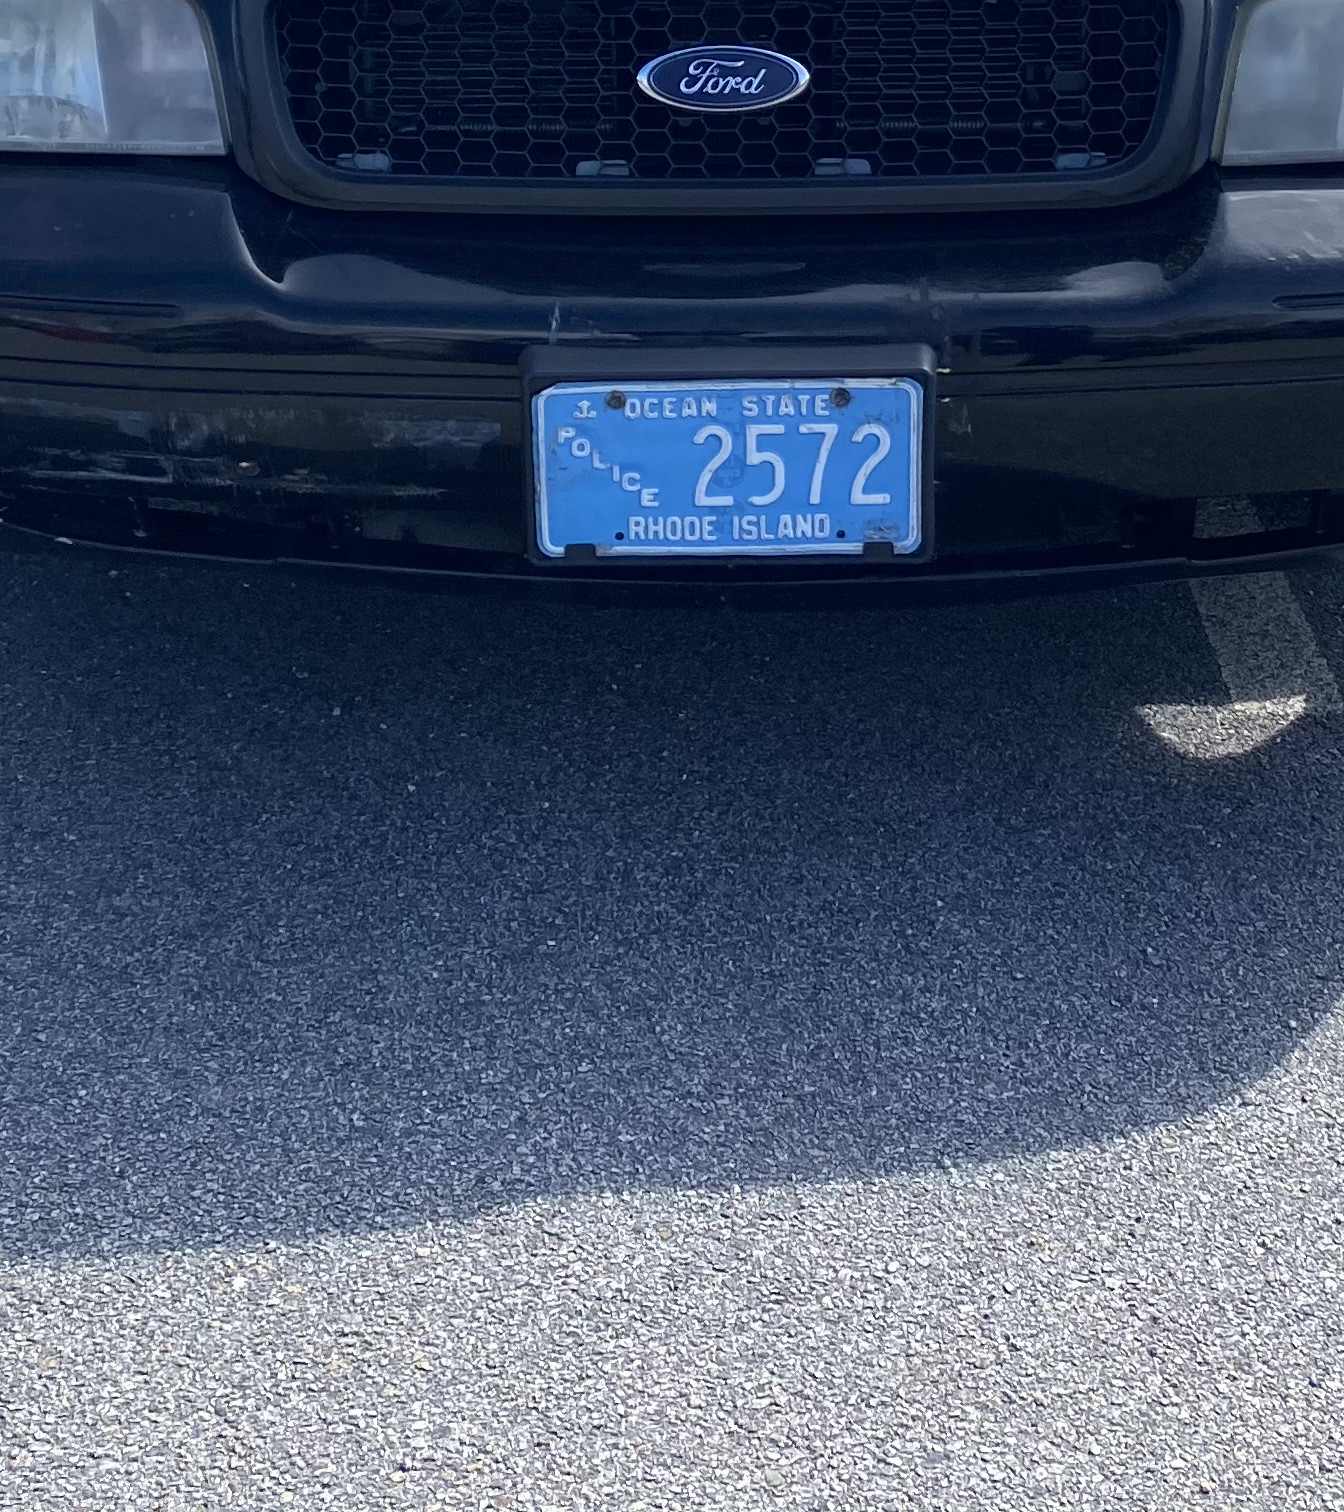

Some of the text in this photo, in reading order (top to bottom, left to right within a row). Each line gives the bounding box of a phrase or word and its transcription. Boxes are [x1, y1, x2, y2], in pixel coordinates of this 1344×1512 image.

[679, 58, 767, 95] Ford
[624, 394, 831, 419] OCEAN STATE
[557, 426, 661, 508] POLICE
[692, 423, 892, 508] 2572
[628, 513, 831, 541] RHODE ISLAND
